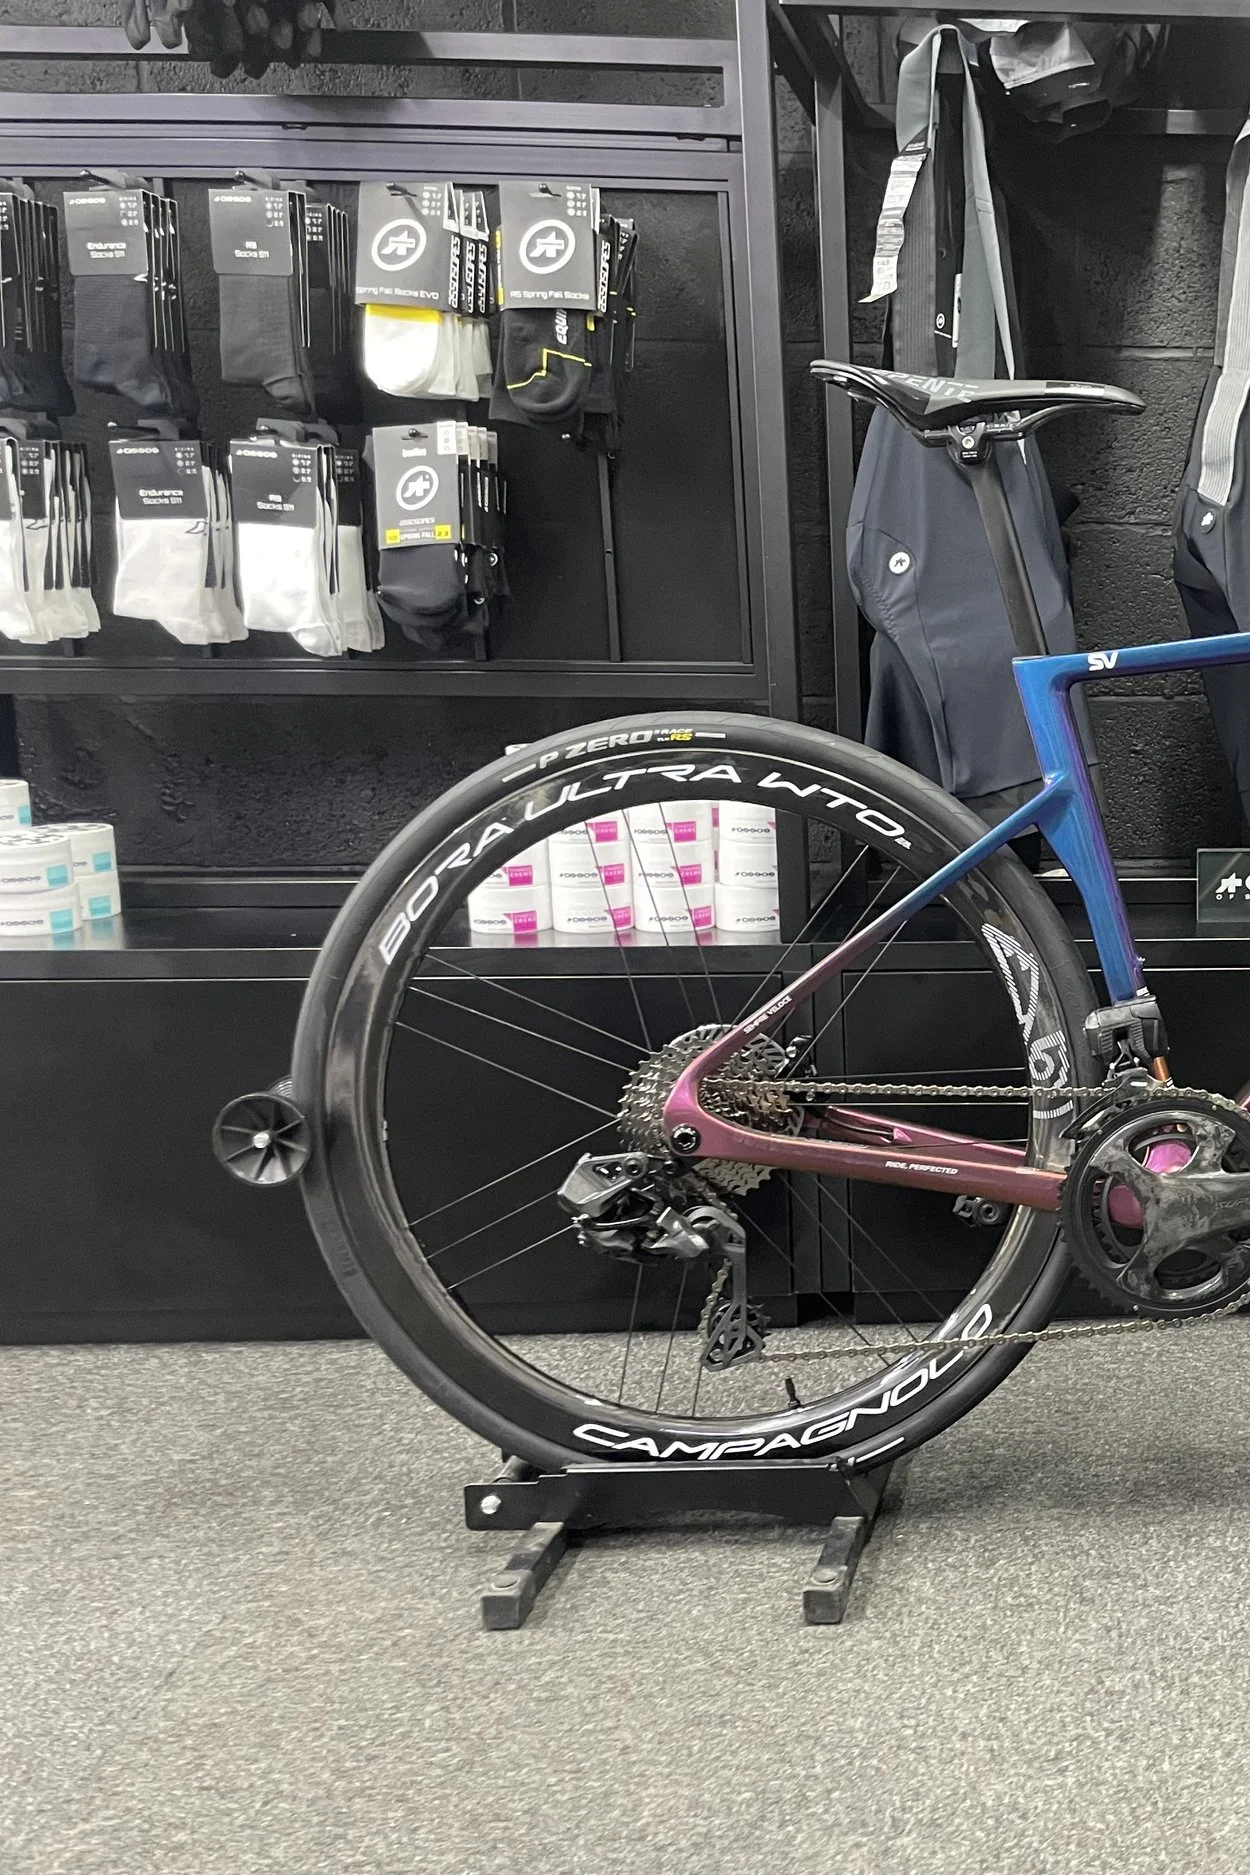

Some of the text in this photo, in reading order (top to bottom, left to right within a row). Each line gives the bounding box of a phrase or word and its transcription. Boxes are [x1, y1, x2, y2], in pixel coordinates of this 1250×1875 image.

[539, 751, 559, 768] P
[565, 730, 653, 759] ZERO
[670, 733, 693, 741] RS
[378, 764, 905, 965] BORA ULTRA WTO
[908, 1162, 958, 1175] PERFECTED
[573, 1304, 992, 1460] CAMPAGNOLO
